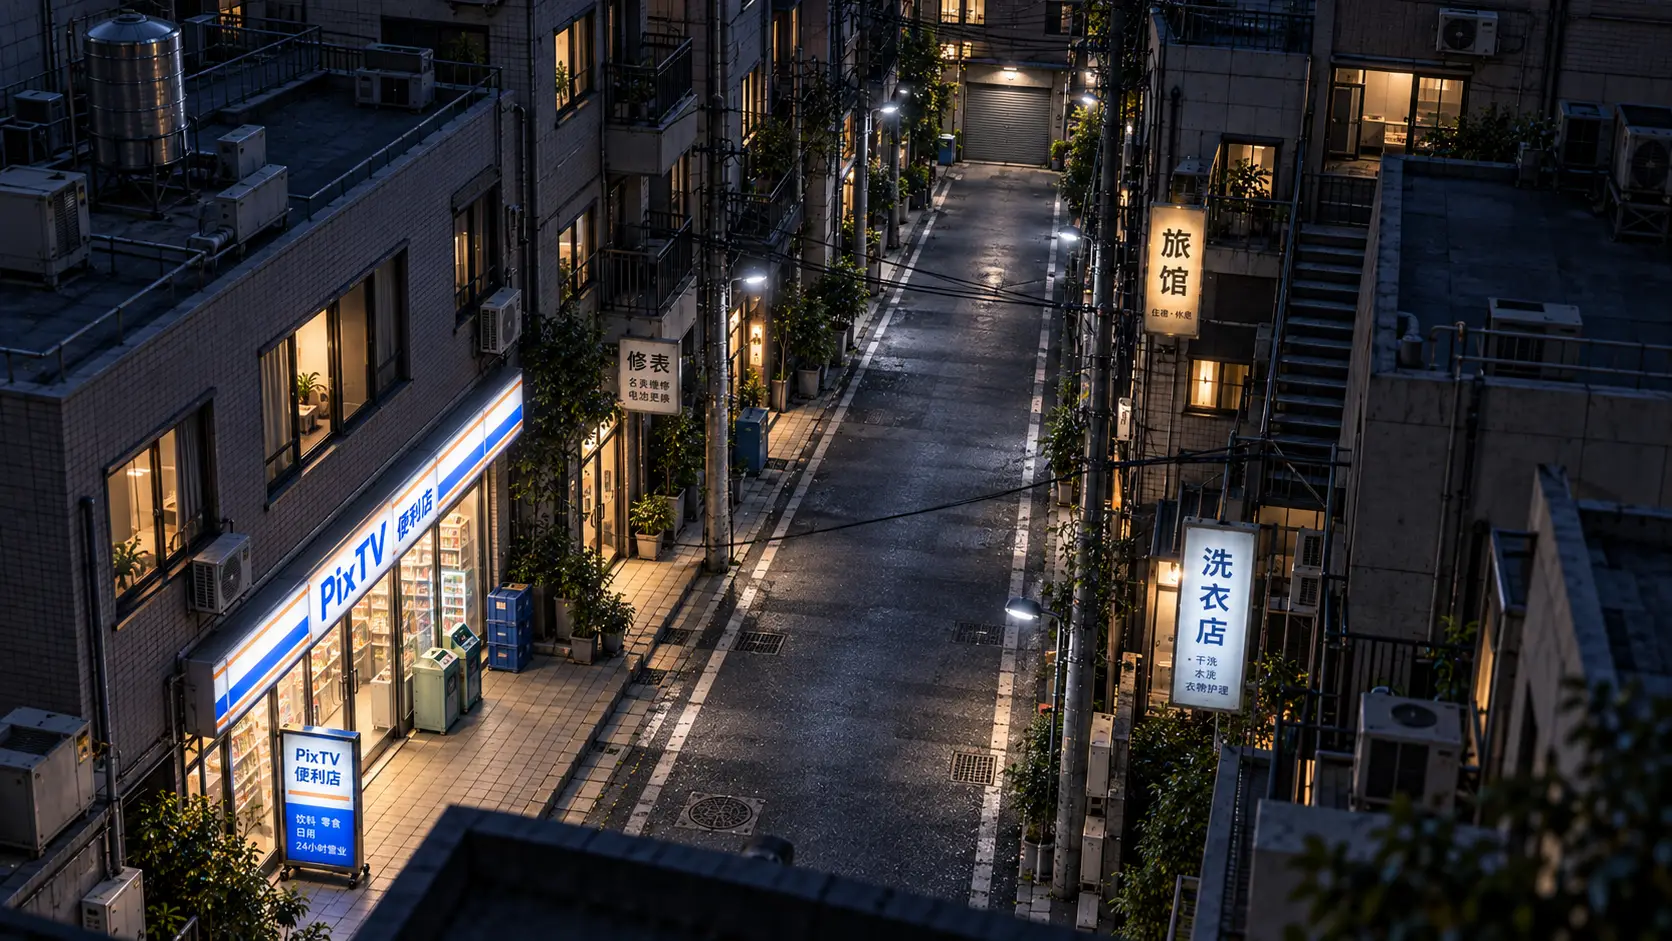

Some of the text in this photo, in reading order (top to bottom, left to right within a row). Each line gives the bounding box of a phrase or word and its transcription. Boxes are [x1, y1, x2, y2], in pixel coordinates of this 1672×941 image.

[1159, 228, 1191, 297] 旅馆
[627, 350, 670, 374] 修表
[320, 488, 433, 622] PixTV 便利店
[1195, 547, 1233, 647] 洗衣店
[1185, 681, 1229, 696] 衣物护理
[295, 747, 341, 766] PixTV
[294, 766, 341, 787] 便利店
[296, 814, 341, 829] 饮料 零食
[296, 827, 316, 839] 日用
[296, 841, 347, 856] 24小时营业
